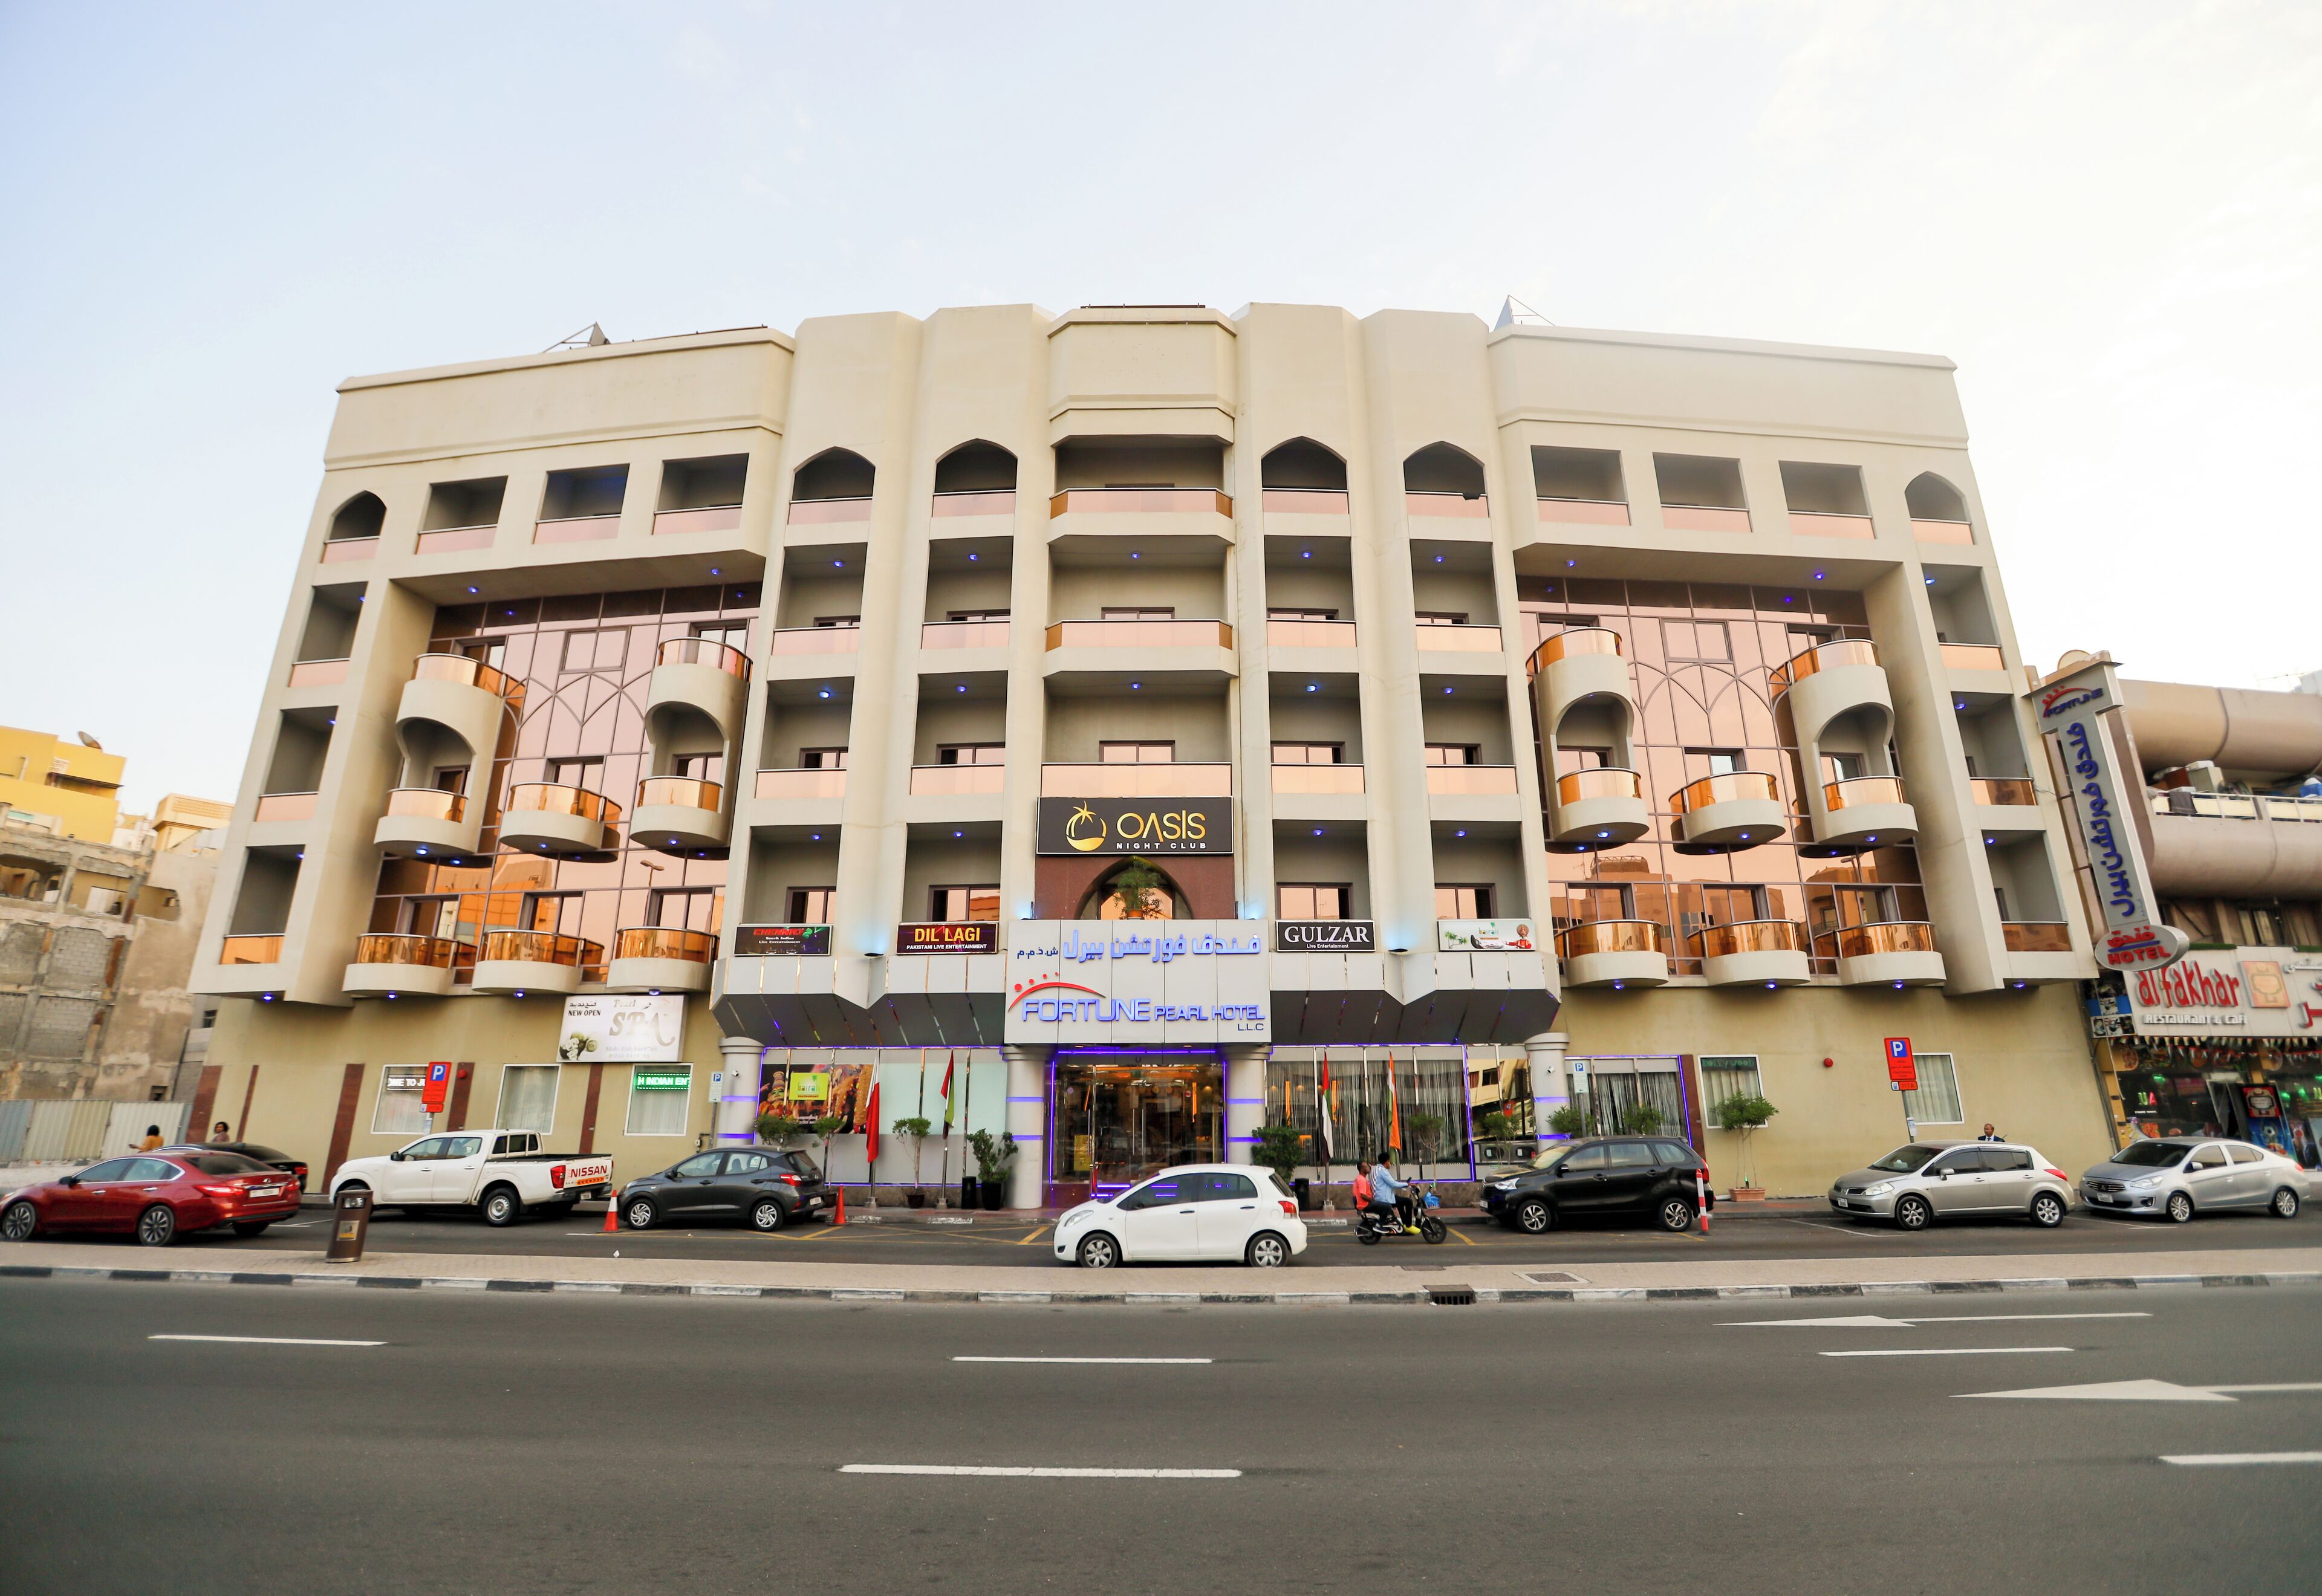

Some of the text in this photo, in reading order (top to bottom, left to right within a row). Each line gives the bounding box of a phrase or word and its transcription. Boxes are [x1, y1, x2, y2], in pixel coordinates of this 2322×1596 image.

[2046, 687, 2103, 718] FORTUNE
[2066, 722, 2099, 779] فندق
[1116, 809, 1206, 842] OASIS
[914, 927, 980, 942] DIL LAGI
[1192, 933, 1261, 955] فندق
[1284, 926, 1370, 943] GULZAR
[2107, 925, 2156, 948] فندق
[1063, 929, 1104, 963] بيرل
[2107, 945, 2172, 965] HOTEL
[1022, 998, 1266, 1022] FORTUNE PEARL HOTEL
[609, 1011, 676, 1046] SPA
[1892, 1041, 1904, 1057] P
[432, 1065, 444, 1080] P
[646, 1077, 674, 1085] INDIAN
[570, 1165, 607, 1178] NISSAN
